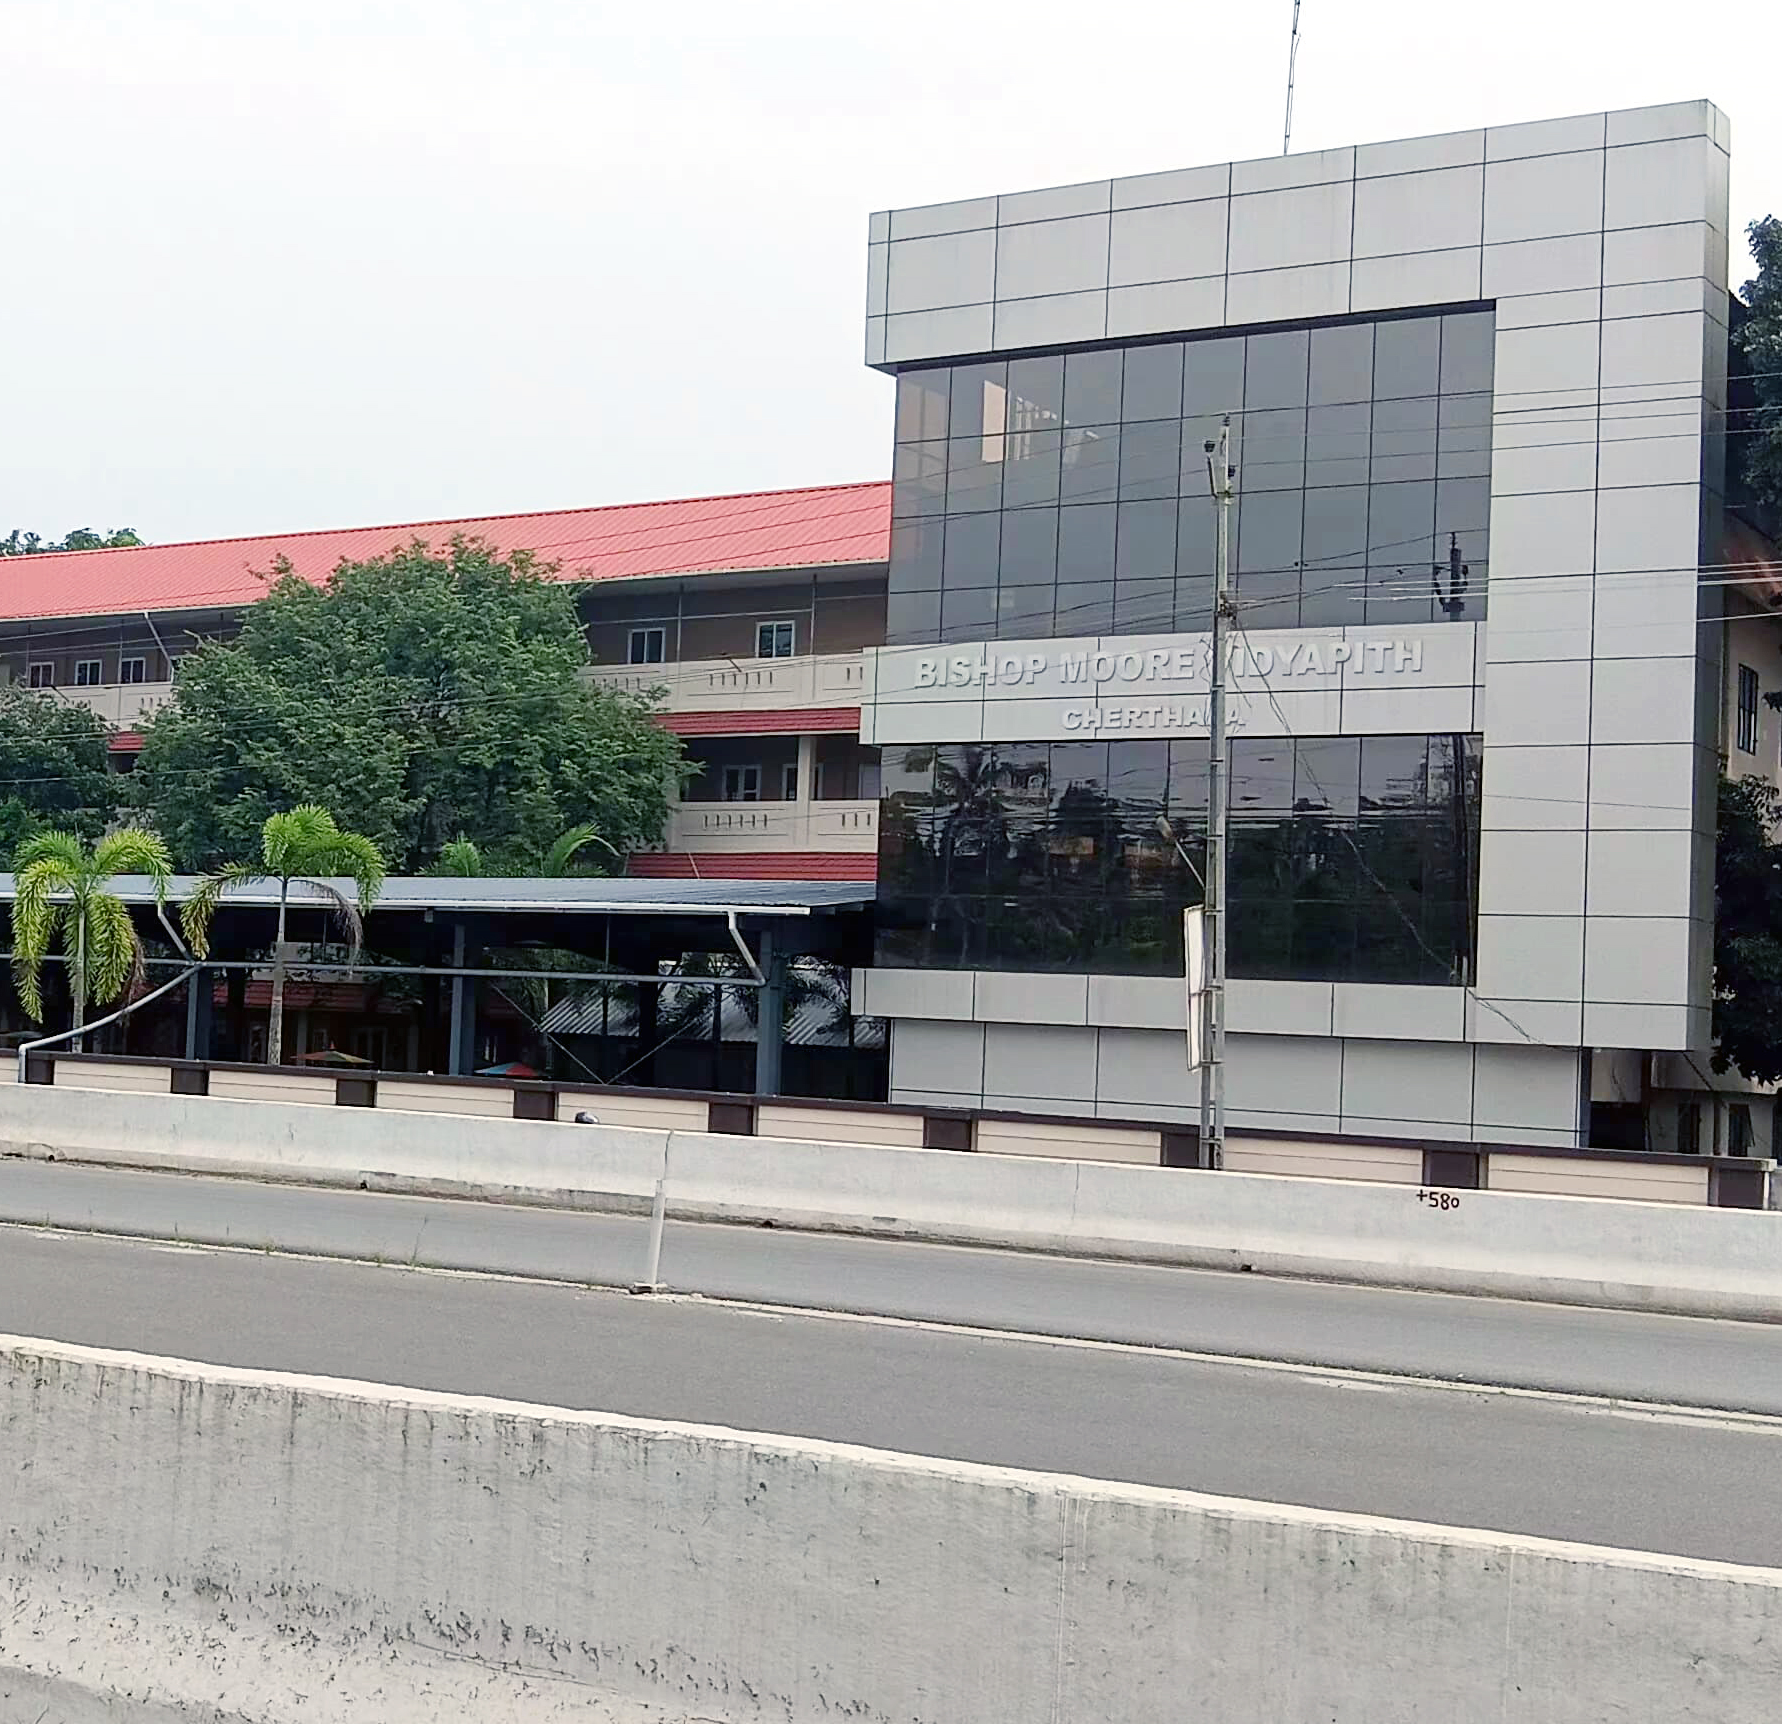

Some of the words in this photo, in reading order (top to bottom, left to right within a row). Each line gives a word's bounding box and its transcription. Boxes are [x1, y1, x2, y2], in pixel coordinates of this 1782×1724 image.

[915, 654, 1047, 688] BISHOP
[1059, 649, 1196, 684] MOORE
[1061, 705, 1247, 731] CHERTHAA
[1415, 1189, 1460, 1211] +580
